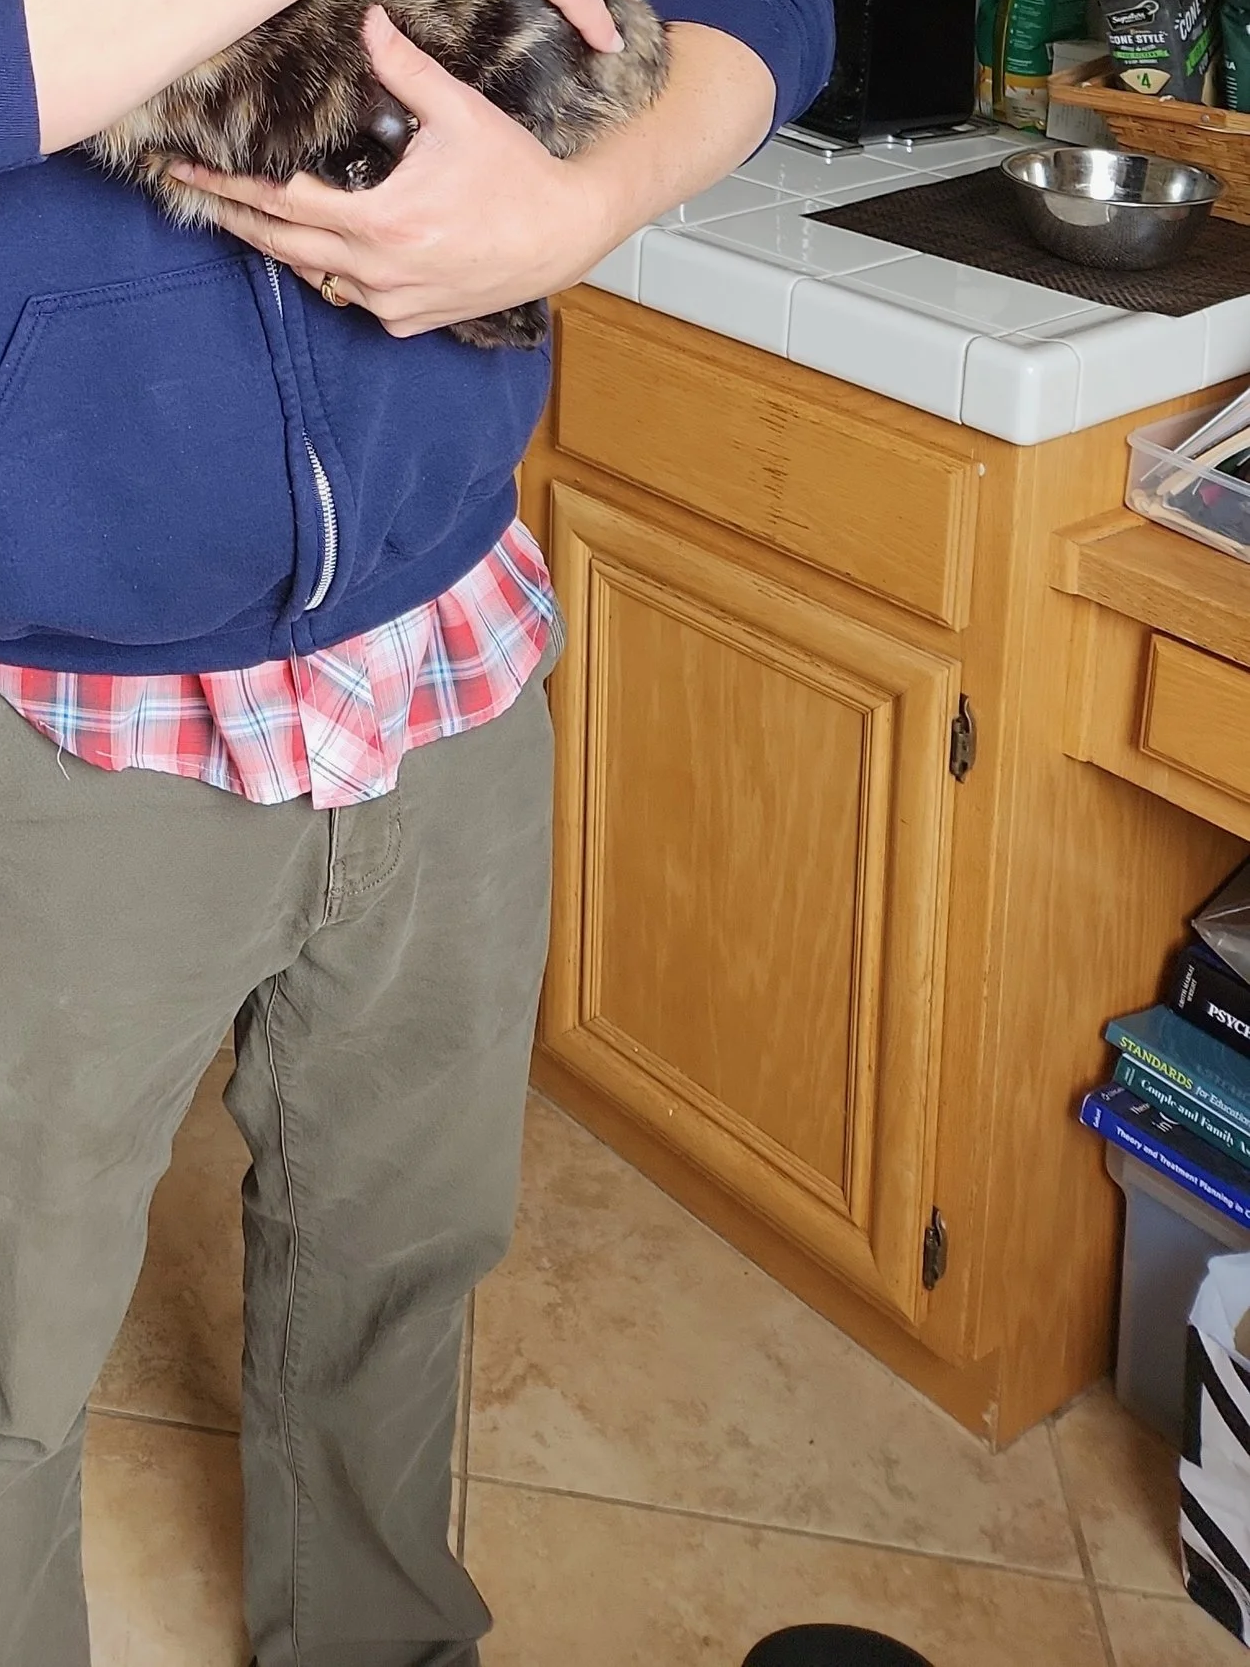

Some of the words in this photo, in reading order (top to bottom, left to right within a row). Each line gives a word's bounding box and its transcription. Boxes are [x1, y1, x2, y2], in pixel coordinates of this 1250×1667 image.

[1109, 34, 1134, 45] CONE
[1136, 33, 1166, 44] STYLE
[1119, 1036, 1194, 1090] STANDARDS
[1195, 1085, 1210, 1099] for
[1140, 1079, 1177, 1107] Couple
[1178, 1104, 1199, 1122] and
[1200, 1116, 1235, 1147] Family
[1116, 1125, 1143, 1150] Theory
[1142, 1144, 1159, 1160] and
[1158, 1154, 1199, 1186] Treatment
[1199, 1179, 1235, 1210] Planning
[1234, 1202, 1244, 1214] in
